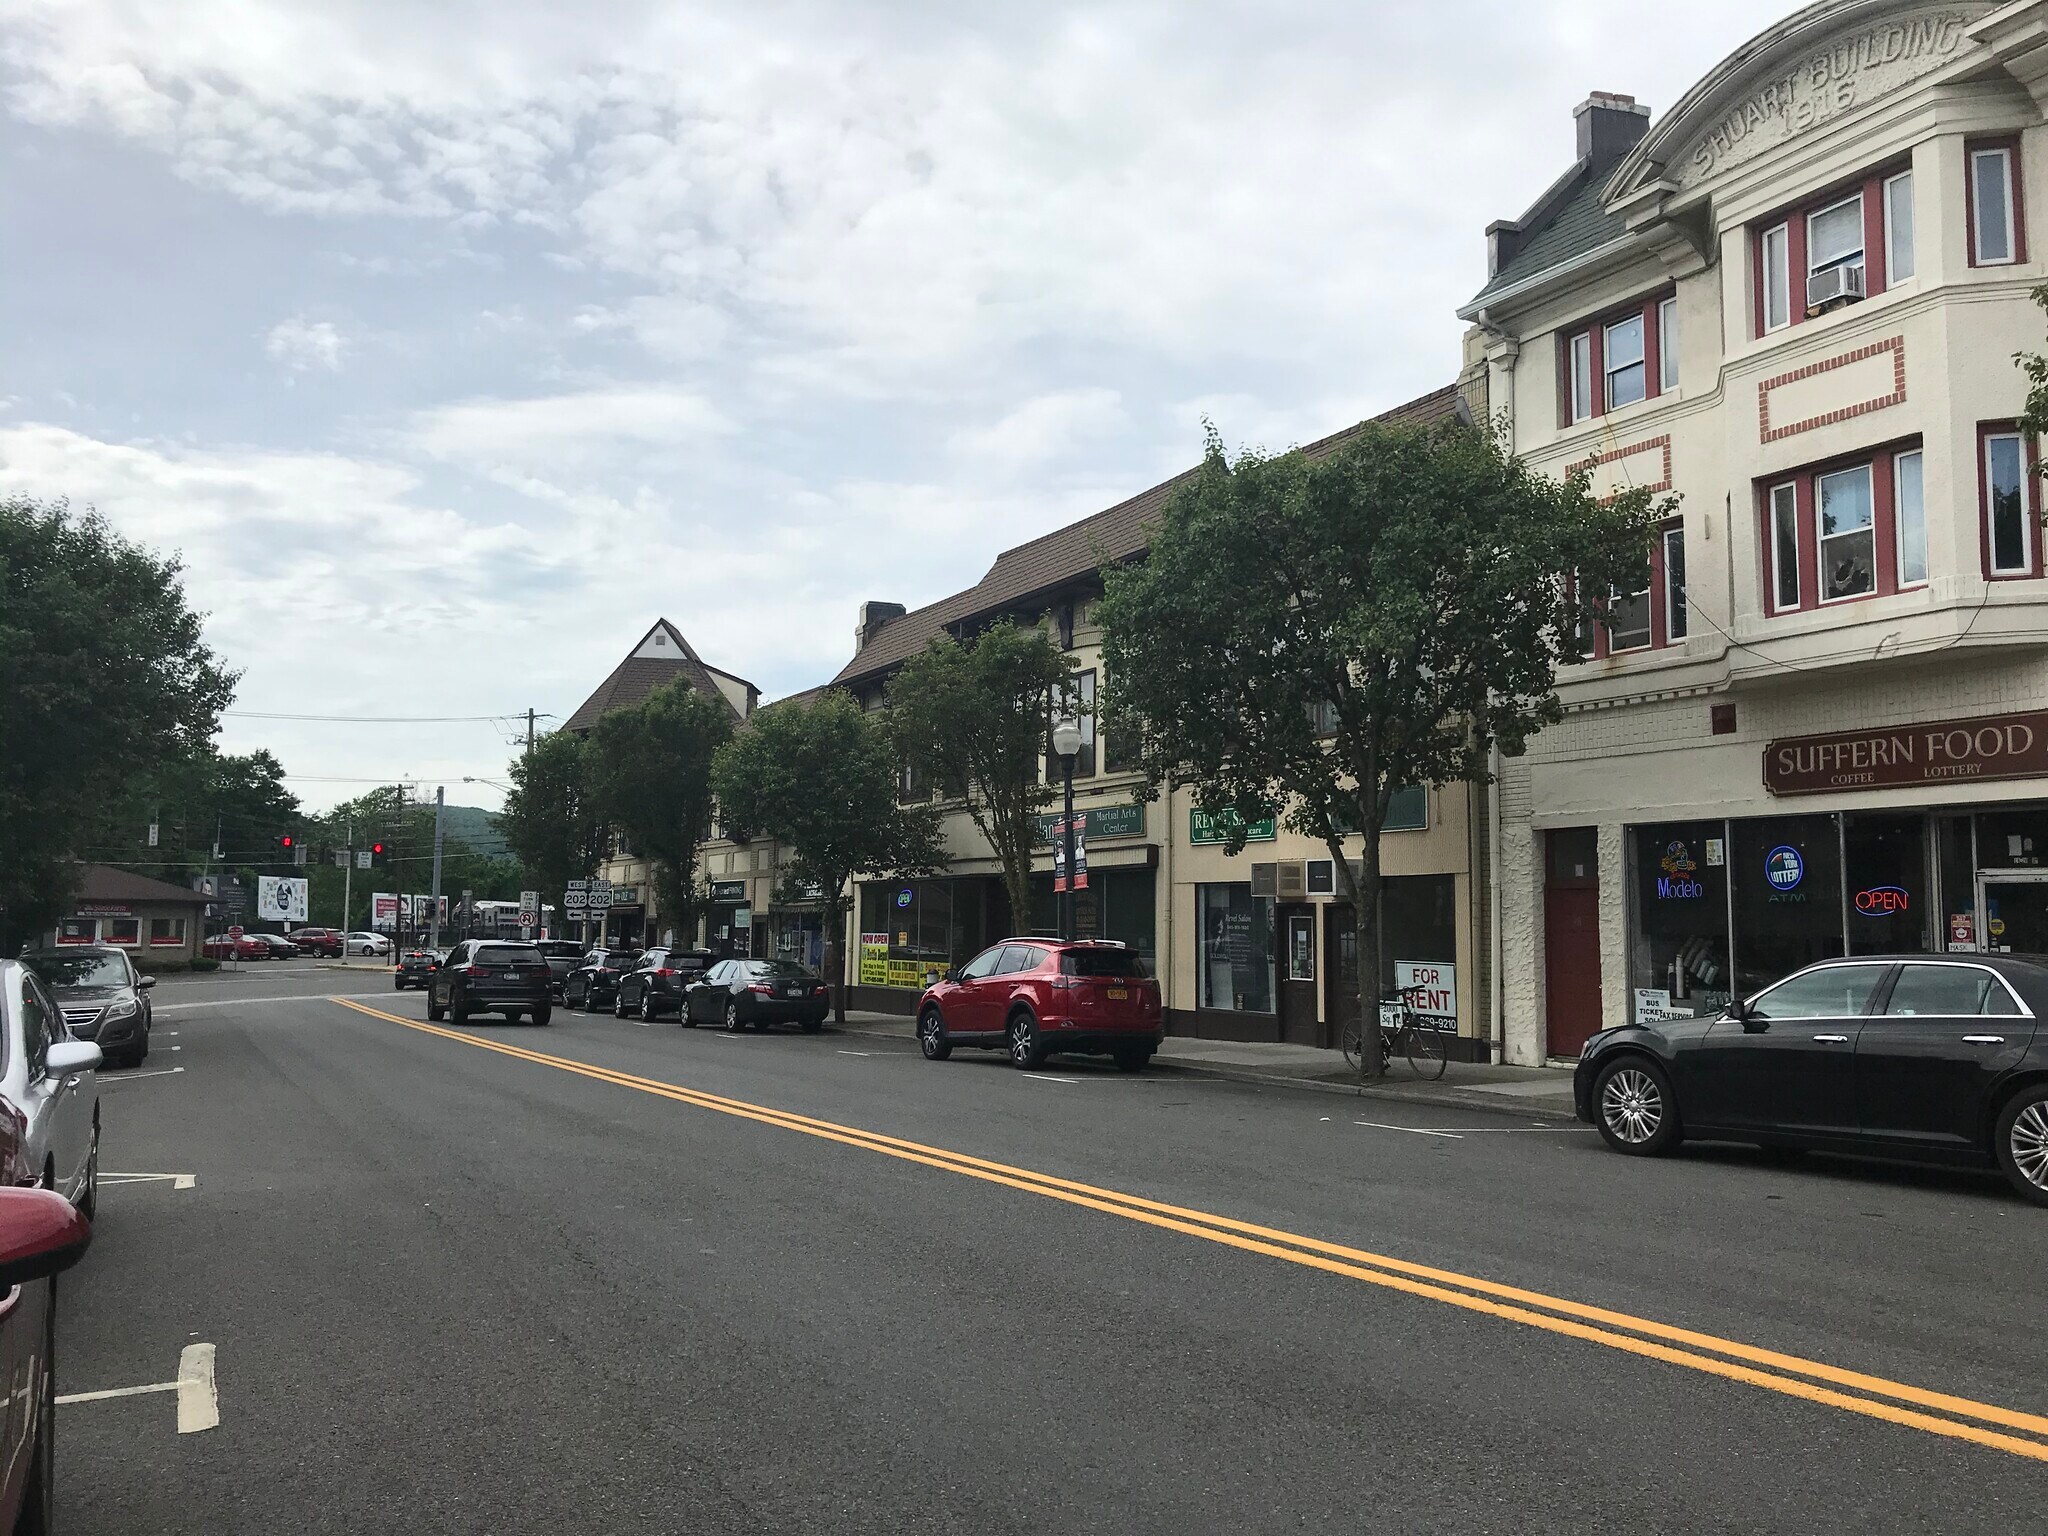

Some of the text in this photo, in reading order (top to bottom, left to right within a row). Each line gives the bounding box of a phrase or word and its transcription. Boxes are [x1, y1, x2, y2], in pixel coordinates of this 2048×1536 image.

[1693, 14, 1966, 176] SHUART BUILDING
[1778, 724, 2034, 776] SUFFERN FOOD
[1831, 763, 1983, 785] COFFEE LOTTERY
[1096, 809, 1137, 821] Martial Arts
[1103, 823, 1129, 833] Center
[1783, 852, 1795, 860] NEW
[1784, 860, 1798, 869] YORK
[1770, 869, 1800, 883] LOTTERY
[1657, 877, 1703, 899] Modelo
[566, 894, 586, 904] 202
[590, 895, 610, 904] 202
[1769, 893, 1806, 903] ATM
[1856, 891, 1907, 910] OPEN
[862, 934, 873, 944] NOW
[874, 934, 888, 945] OPEN
[1412, 968, 1439, 984] FOR
[1405, 989, 1451, 1011] RENT
